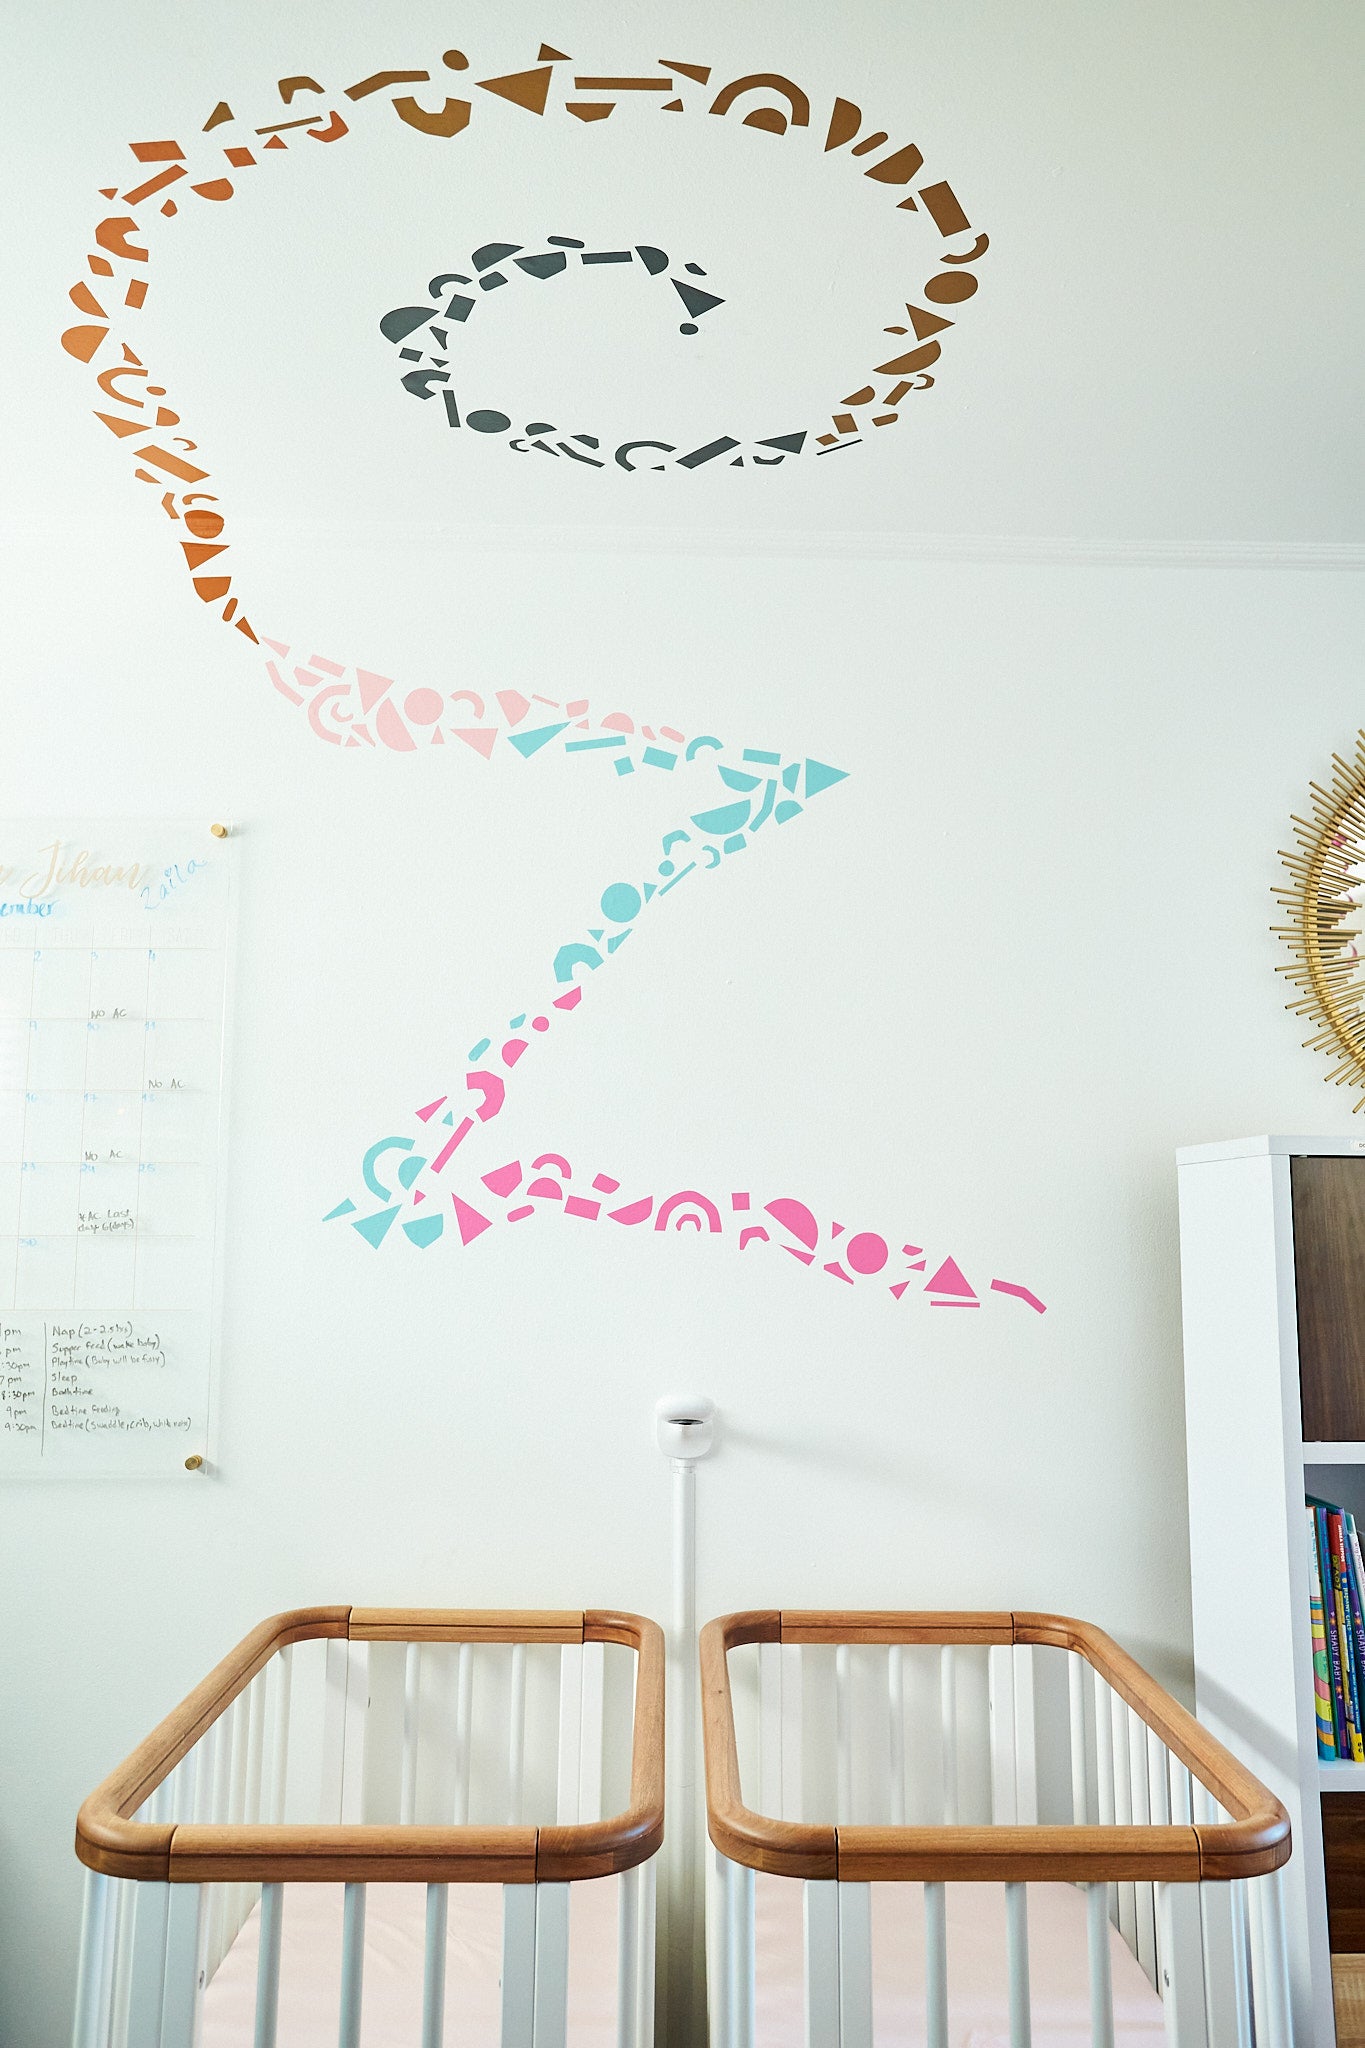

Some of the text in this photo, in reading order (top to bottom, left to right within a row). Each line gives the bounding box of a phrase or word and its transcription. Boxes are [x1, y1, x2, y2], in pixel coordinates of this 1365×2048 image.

[20, 840, 149, 899] Jihan
[112, 1008, 127, 1019] AC
[170, 1078, 185, 1089] AC
[110, 1150, 123, 1159] AC
[53, 1326, 75, 1339] Nap
[1330, 1630, 1342, 1681] SHADY BABY
